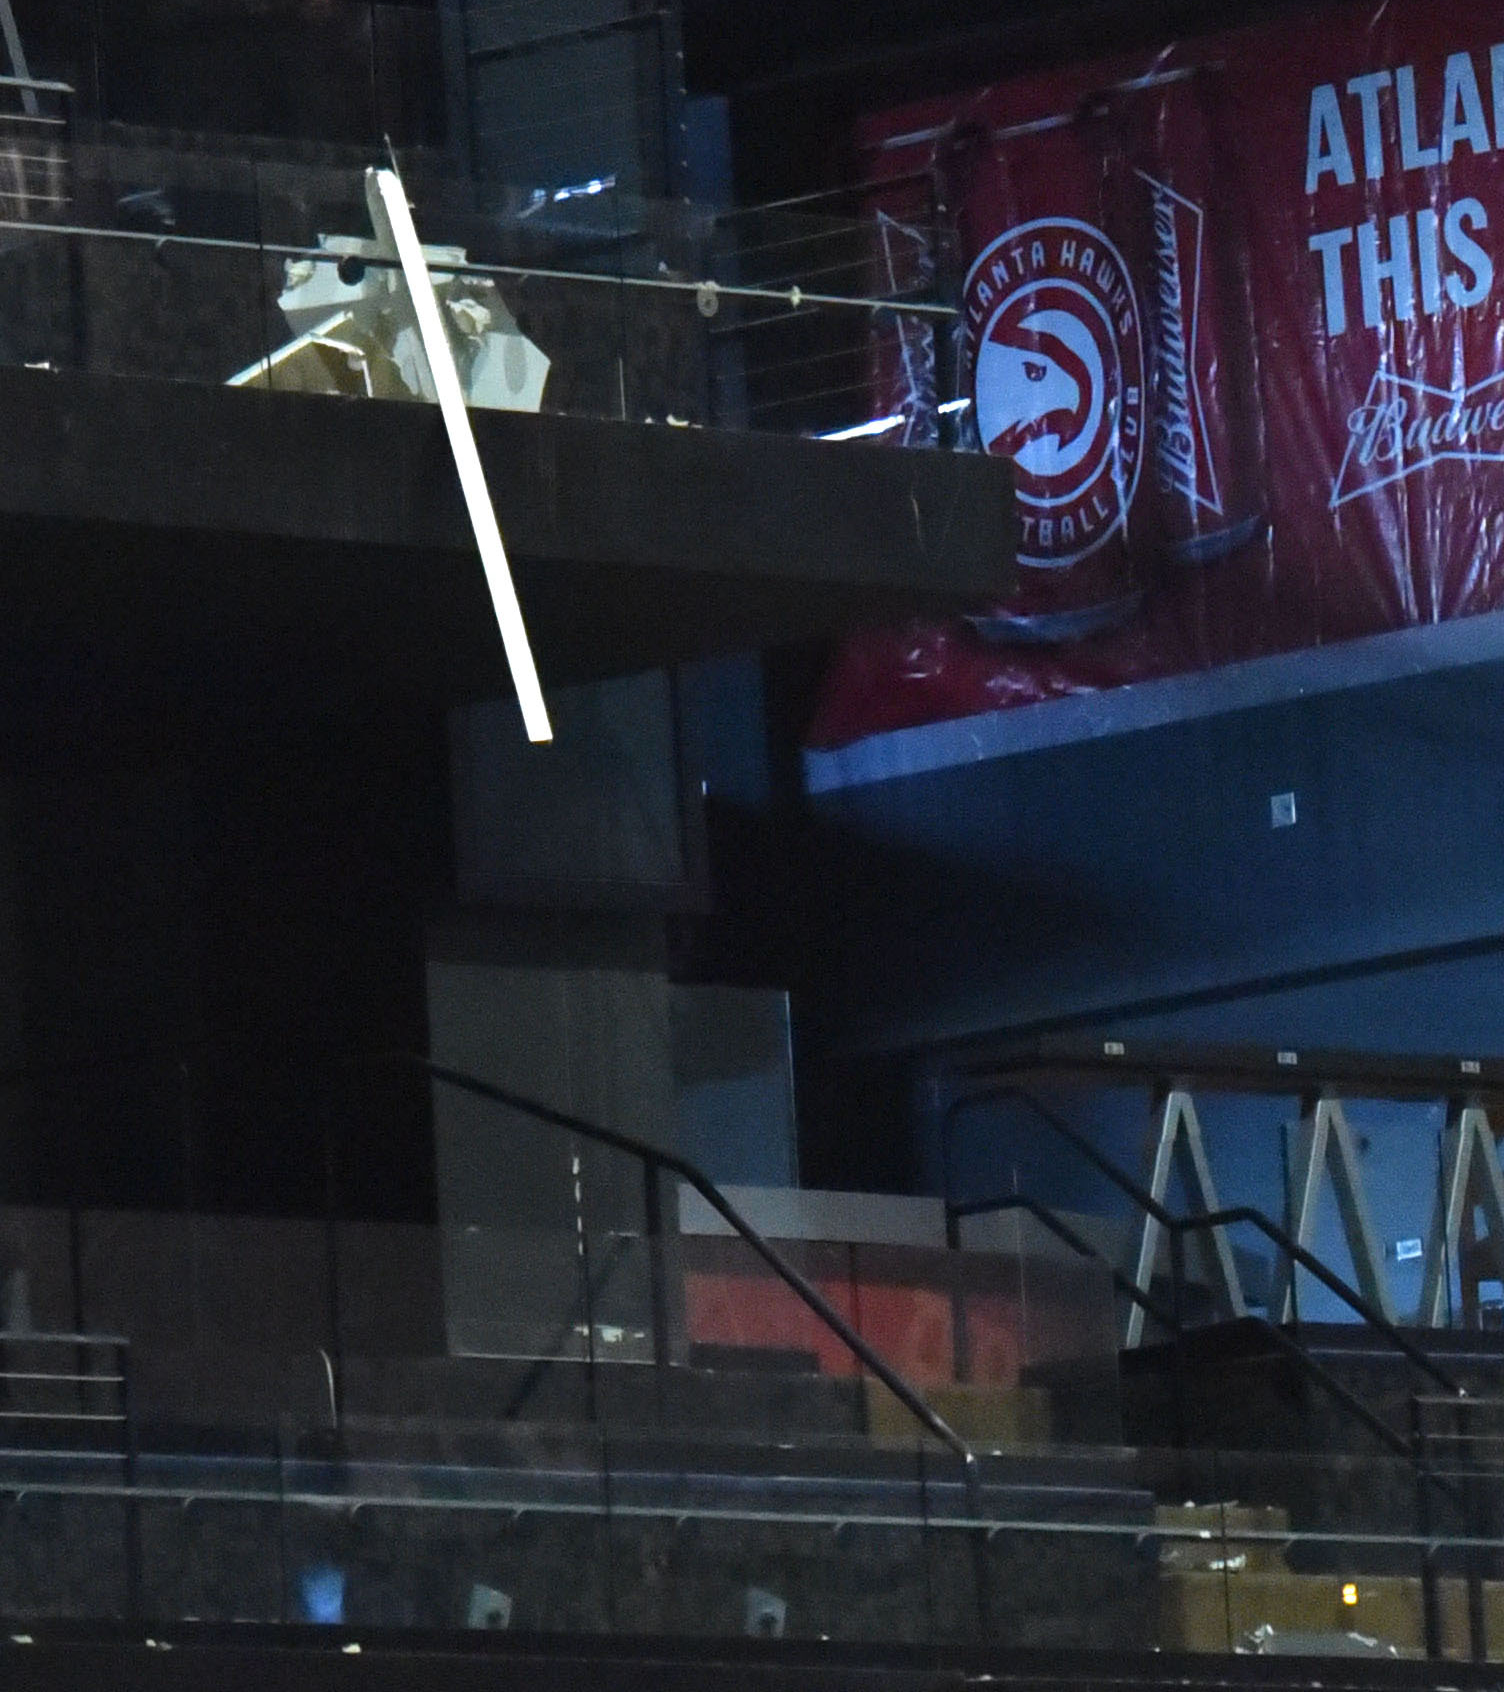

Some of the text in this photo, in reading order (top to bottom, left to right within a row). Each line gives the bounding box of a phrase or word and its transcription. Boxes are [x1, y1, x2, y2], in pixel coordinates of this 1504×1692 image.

[1059, 238, 1134, 337] HAWKS
[1308, 197, 1493, 336] THIS
[1020, 494, 1109, 547] TBALL
